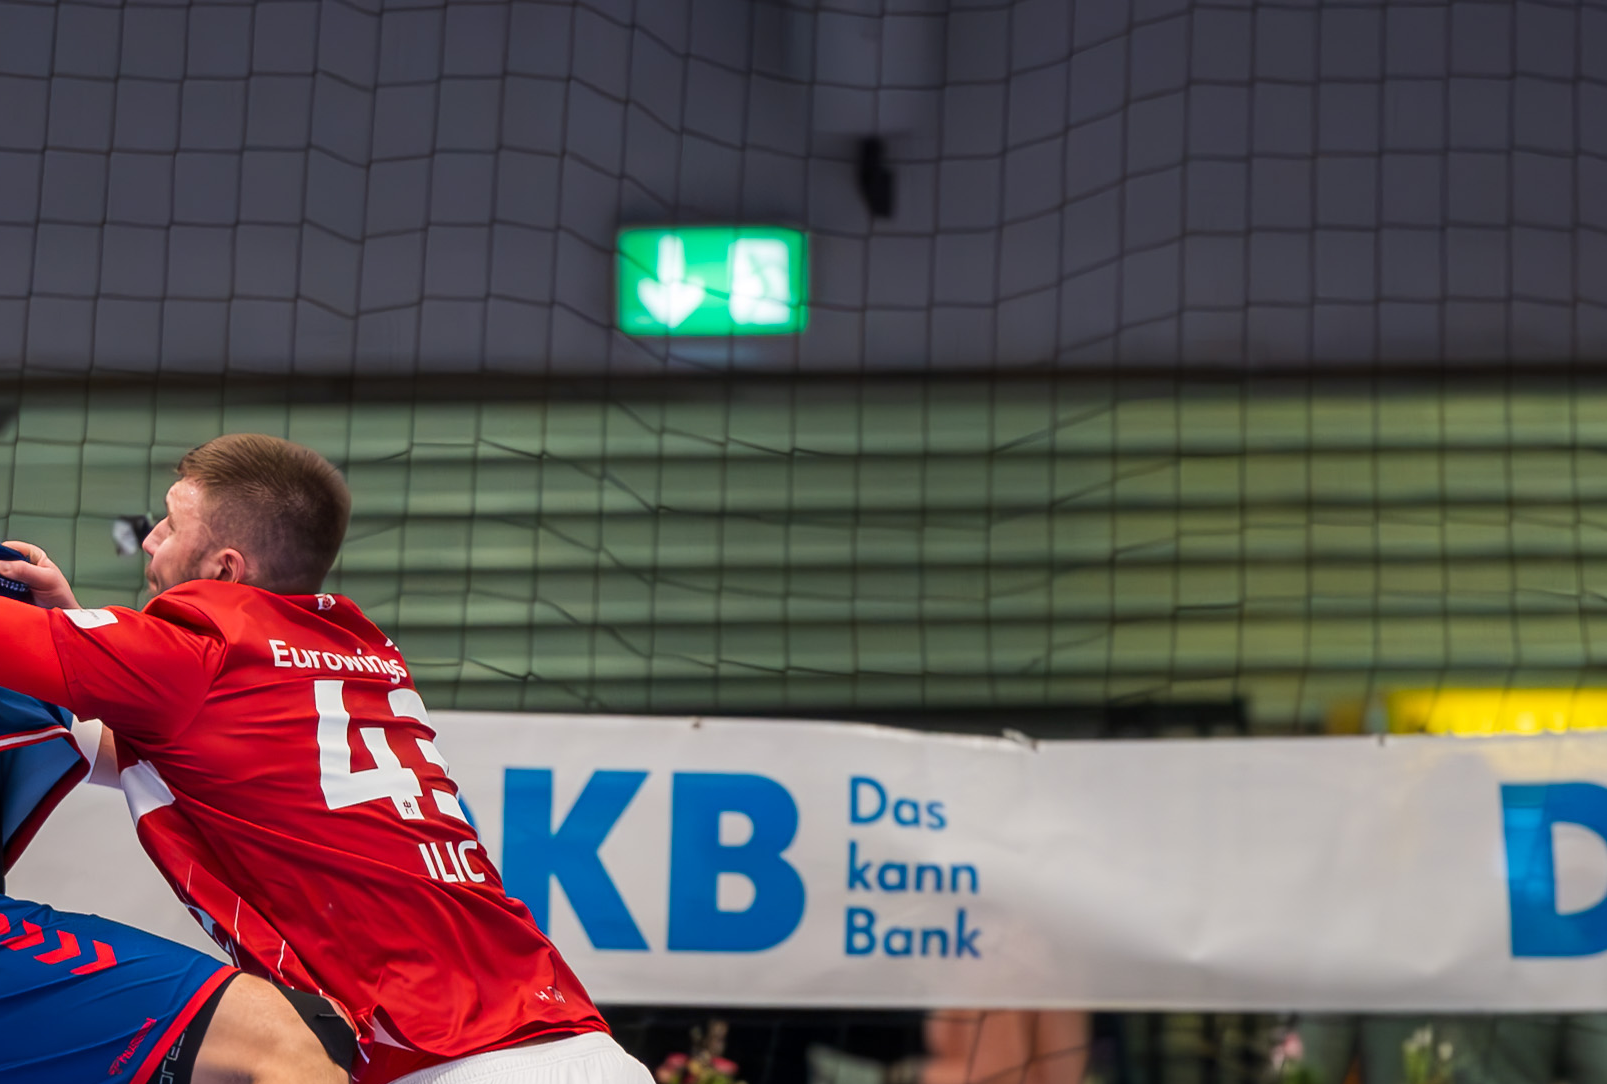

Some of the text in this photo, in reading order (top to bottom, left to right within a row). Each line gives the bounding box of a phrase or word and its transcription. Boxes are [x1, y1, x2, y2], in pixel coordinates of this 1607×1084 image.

[268, 638, 408, 684] Eurowings
[848, 776, 948, 831] Das
[418, 840, 486, 884] ILIC
[459, 767, 806, 953] KB
[847, 840, 980, 894] kann
[843, 907, 982, 959] Bank
